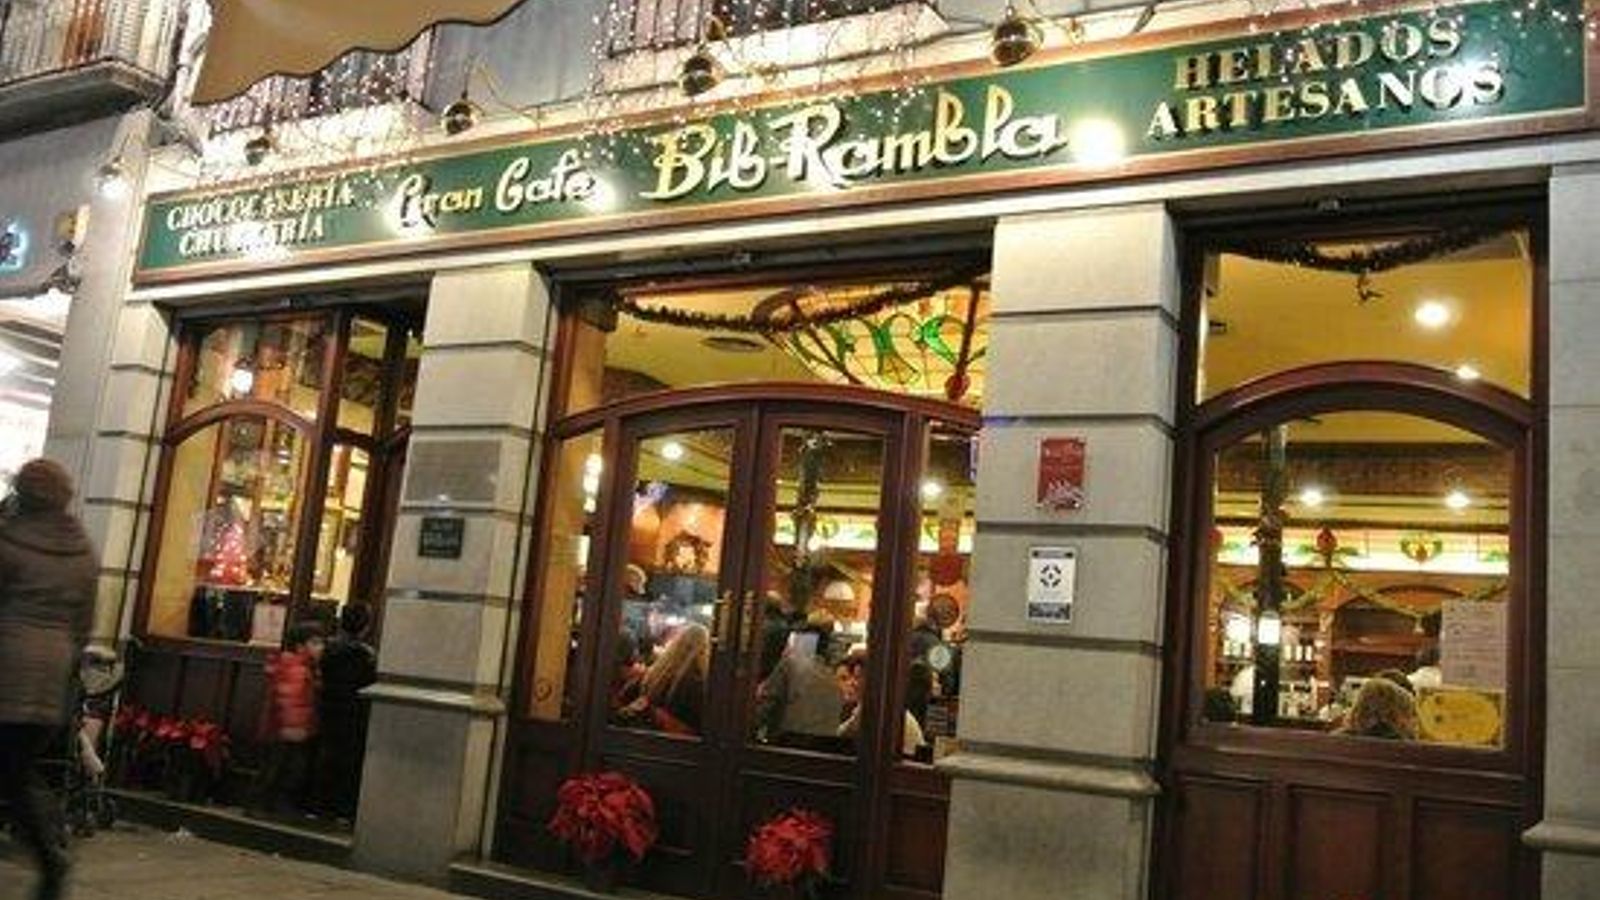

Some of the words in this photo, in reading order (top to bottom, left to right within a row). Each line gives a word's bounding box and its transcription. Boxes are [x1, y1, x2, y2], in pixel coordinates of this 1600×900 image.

[1175, 17, 1462, 89] HELADOS
[1149, 61, 1504, 138] ARTESANOS
[392, 173, 483, 228] Gran
[640, 84, 1067, 200] Bib-Rambla
[178, 208, 324, 256] CHUERÍA
